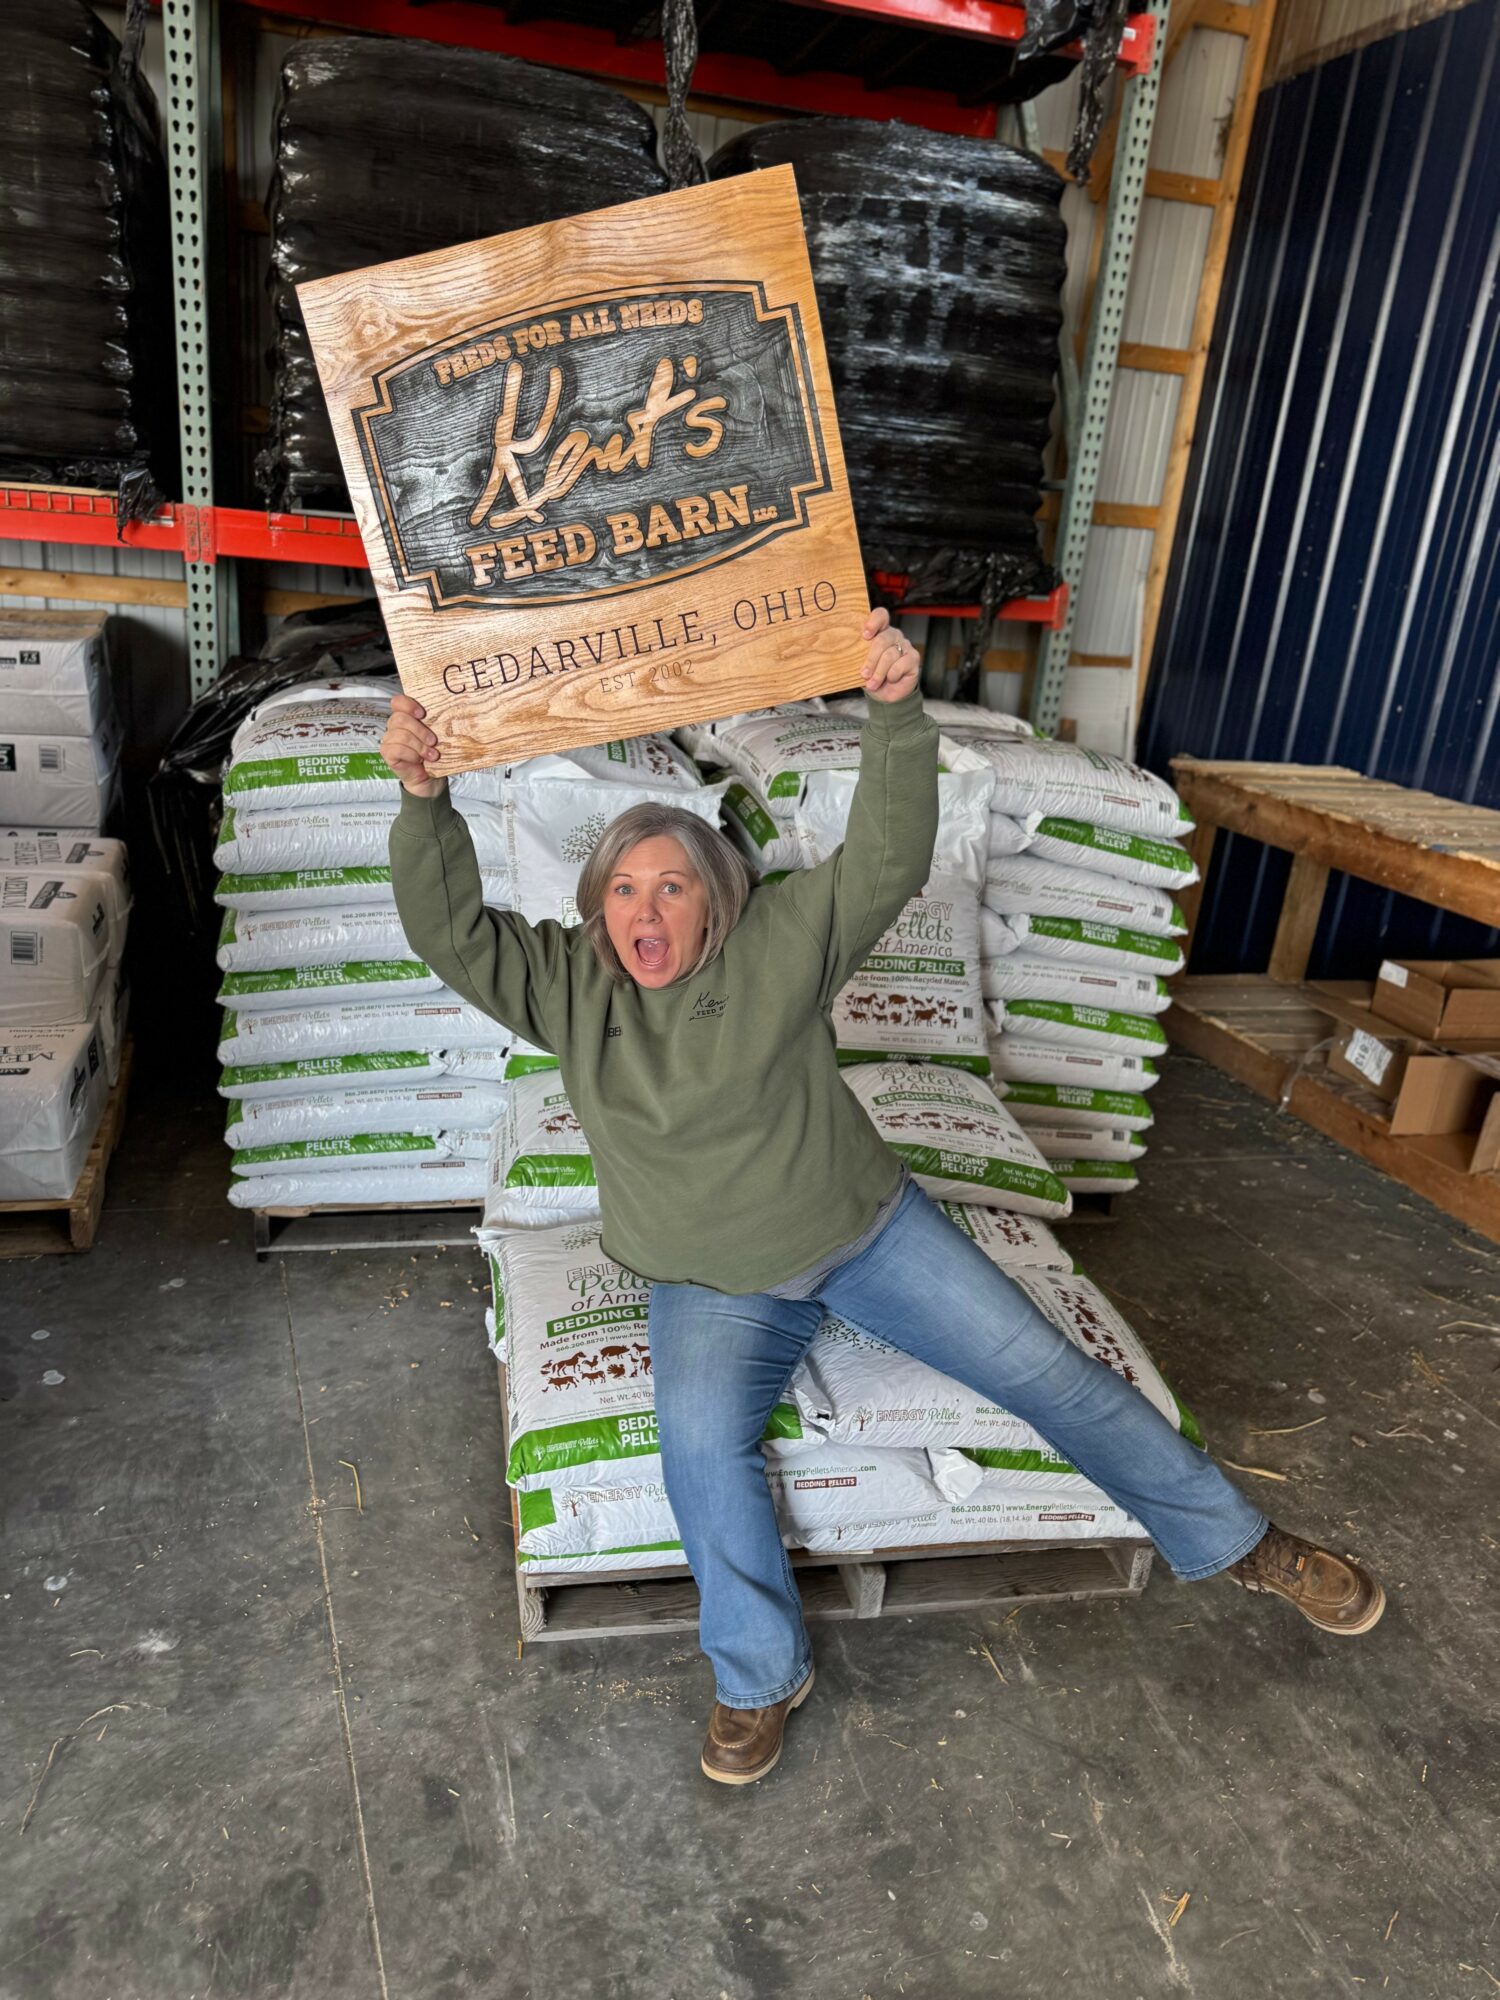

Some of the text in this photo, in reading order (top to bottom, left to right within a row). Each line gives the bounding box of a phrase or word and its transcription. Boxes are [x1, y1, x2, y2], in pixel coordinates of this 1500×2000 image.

[432, 299, 703, 385] FEEDS FOR ALL NEEDS
[469, 354, 727, 529] Kent's
[466, 523, 597, 587] FEED
[607, 485, 751, 556] BARN
[443, 581, 837, 695] CEDARVILLE, OHIO
[600, 660, 694, 693] EST 2002
[297, 755, 350, 767] BEDDING
[299, 765, 346, 776] PELLETS
[297, 870, 344, 881] PELLETS
[893, 939, 953, 957] America
[918, 960, 961, 974] PELLETS
[297, 970, 342, 981] PELLETS
[297, 1058, 342, 1070] PELLETS
[306, 1140, 350, 1151] PELLETS
[940, 1151, 988, 1168] BEDDING
[941, 1162, 985, 1177] PELLETS
[566, 1262, 625, 1283] ENE
[571, 1293, 650, 1312] of Ame
[553, 1308, 636, 1333] BEDDING
[540, 1322, 648, 1350] Made from 100% Re
[876, 1407, 961, 1421] ENERGY Pellets
[618, 1415, 658, 1431] BEDD
[622, 1430, 660, 1447] PELL
[796, 1478, 855, 1488] BEDDING PELLETS
[587, 1486, 642, 1503] ENERGY
[951, 1503, 1000, 1513] 866.200.8870
[951, 1517, 963, 1525] Net.
[964, 1516, 976, 1524] Wt.
[978, 1516, 985, 1524] 40
[987, 1515, 999, 1523] lbs.
